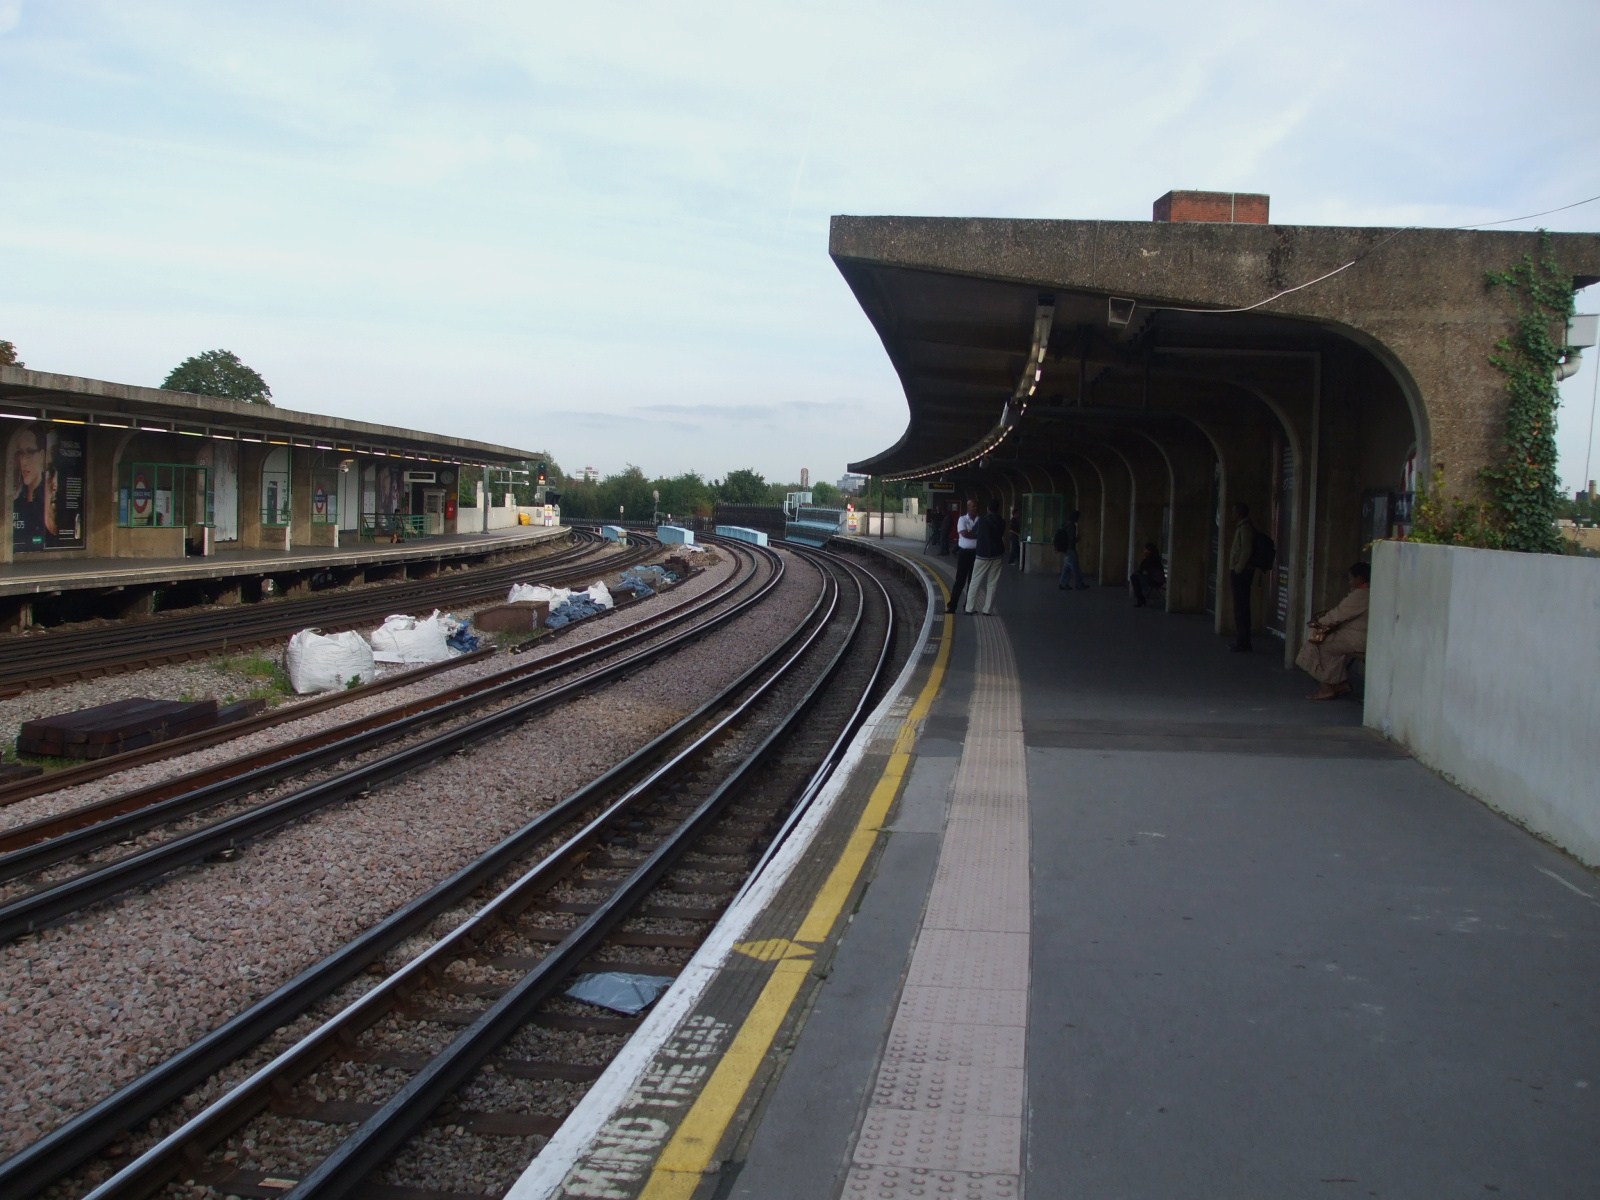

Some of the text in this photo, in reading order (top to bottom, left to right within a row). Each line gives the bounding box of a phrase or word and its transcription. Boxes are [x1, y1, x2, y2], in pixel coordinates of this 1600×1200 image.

[556, 1015, 732, 1199] MIND THE GAP
